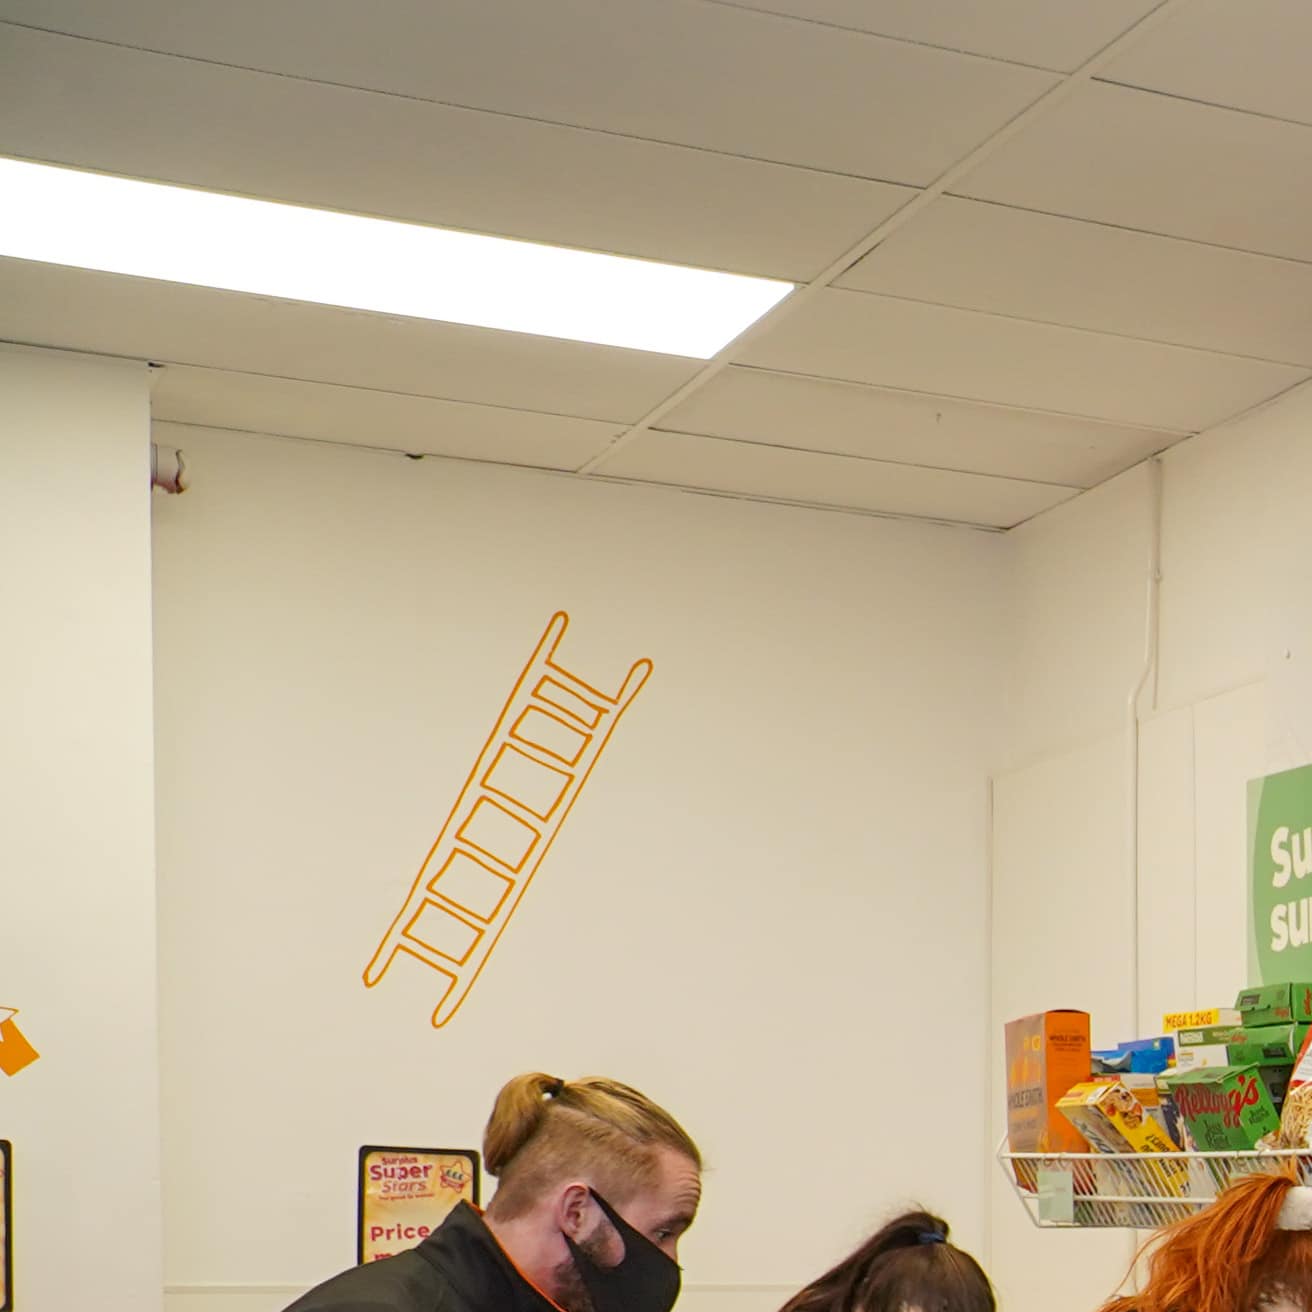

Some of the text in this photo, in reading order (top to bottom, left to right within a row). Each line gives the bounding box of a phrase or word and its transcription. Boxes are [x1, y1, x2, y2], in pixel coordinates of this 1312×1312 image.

[1165, 1014, 1187, 1029] MEGA
[1174, 1074, 1260, 1129] Kellogg's
[369, 1165, 433, 1182] Super
[381, 1180, 427, 1194] Stars
[371, 1224, 431, 1242] Price
